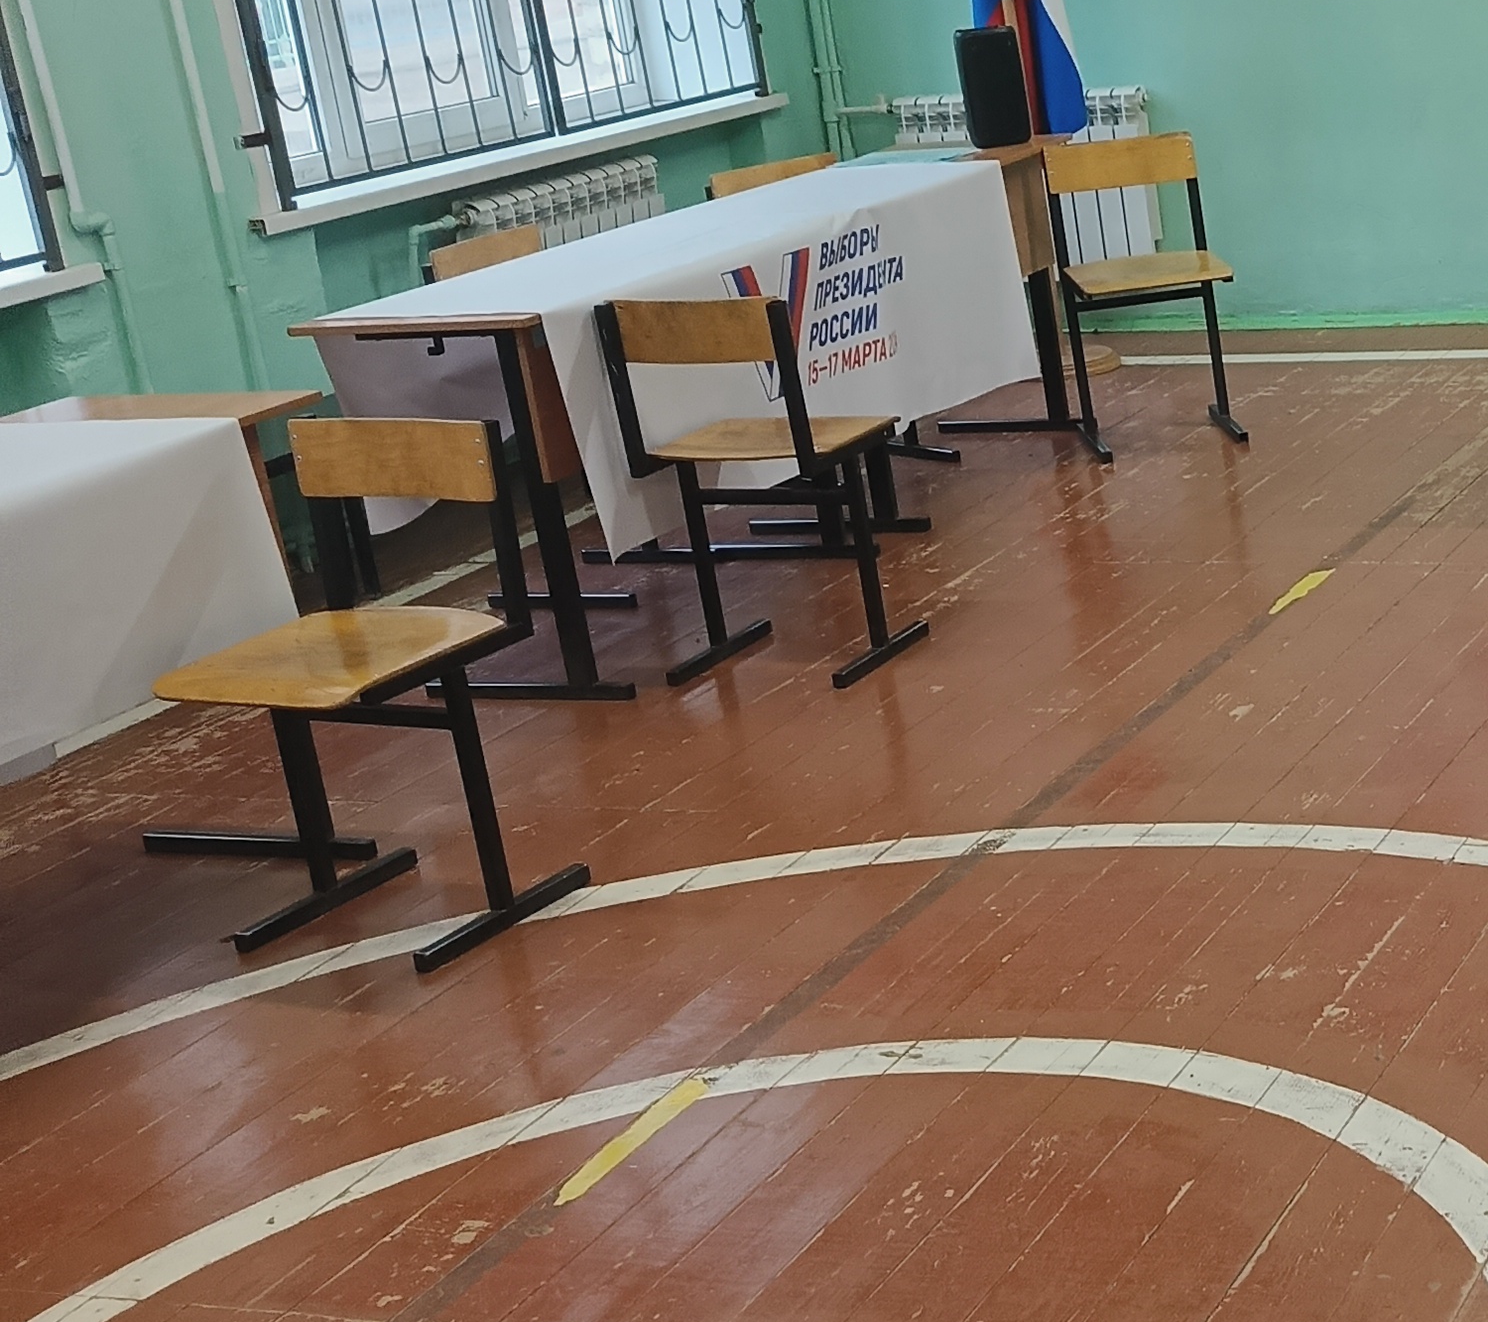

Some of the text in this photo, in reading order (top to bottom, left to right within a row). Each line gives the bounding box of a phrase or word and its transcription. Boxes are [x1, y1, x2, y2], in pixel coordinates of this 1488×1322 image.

[819, 224, 879, 271] ВЫБОРЫ
[814, 256, 903, 311] ПРЕЗИДЕНТА
[809, 303, 878, 352] РОССИИ
[841, 337, 887, 374] МАРТА
